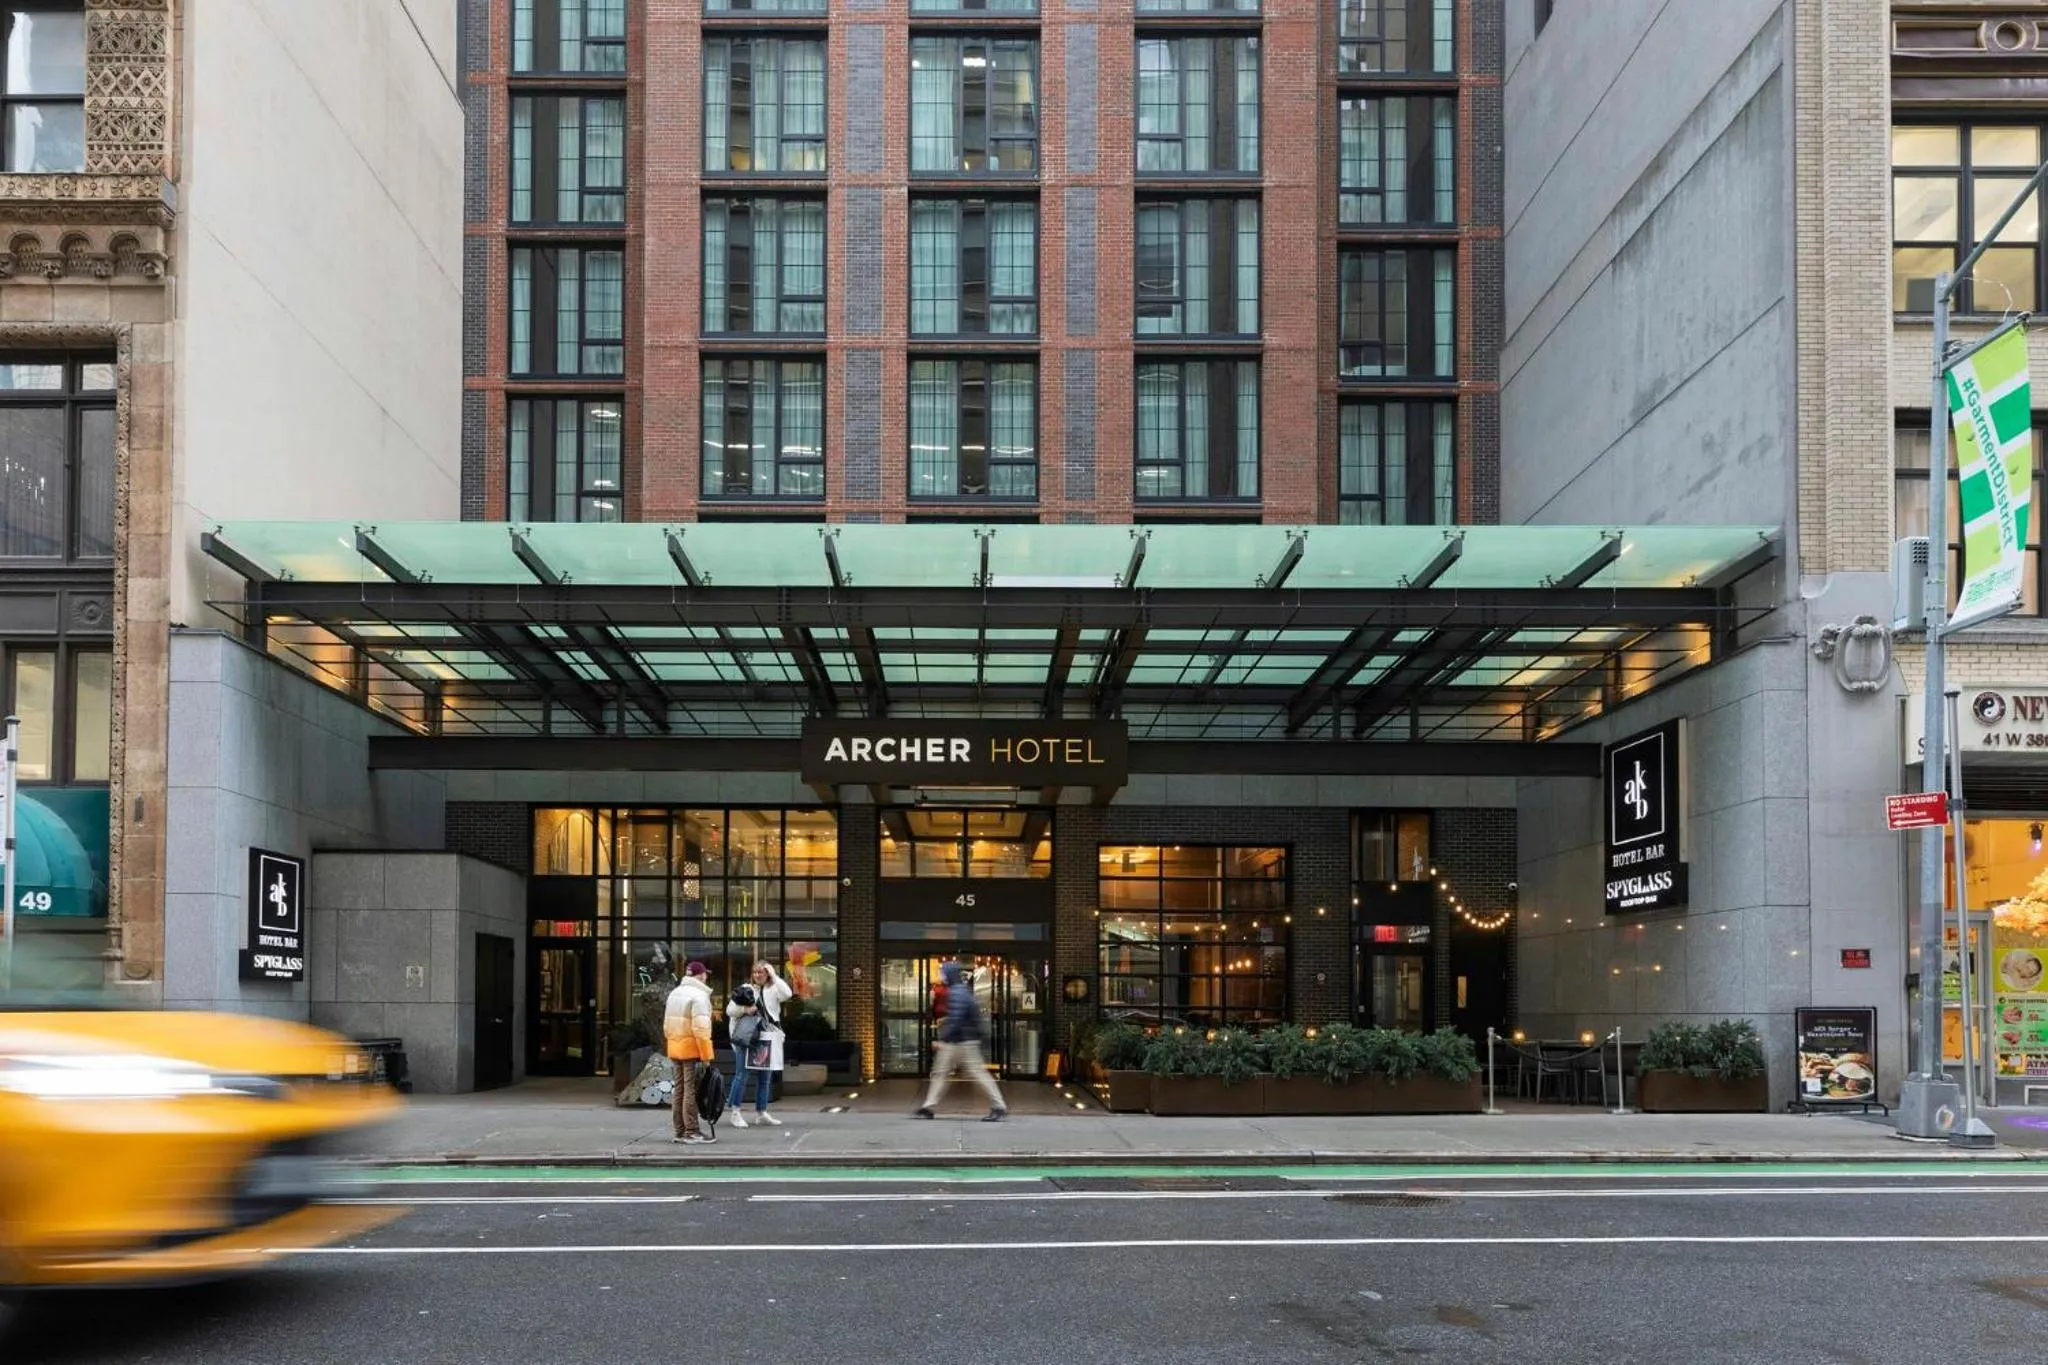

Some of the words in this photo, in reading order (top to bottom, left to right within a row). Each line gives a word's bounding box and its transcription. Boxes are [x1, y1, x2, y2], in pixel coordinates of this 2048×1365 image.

[1962, 377, 2014, 548] #GarmentDistrict
[2012, 695, 2048, 721] NE
[1983, 733, 2000, 746] 41
[2006, 733, 2022, 746] W
[824, 737, 972, 762] ARCHER
[991, 738, 1105, 763] HOTEL
[1902, 795, 1938, 805] STANDING
[1612, 849, 1644, 868] HOTEL
[1645, 844, 1665, 861] BAR
[1606, 870, 1673, 900] SPYGLASS
[19, 891, 52, 911] 49
[955, 894, 976, 907] 45
[259, 934, 284, 947] HOTEL
[284, 937, 299, 949] BAR
[254, 954, 303, 971] SPYGLASS
[1024, 995, 1033, 1006] A
